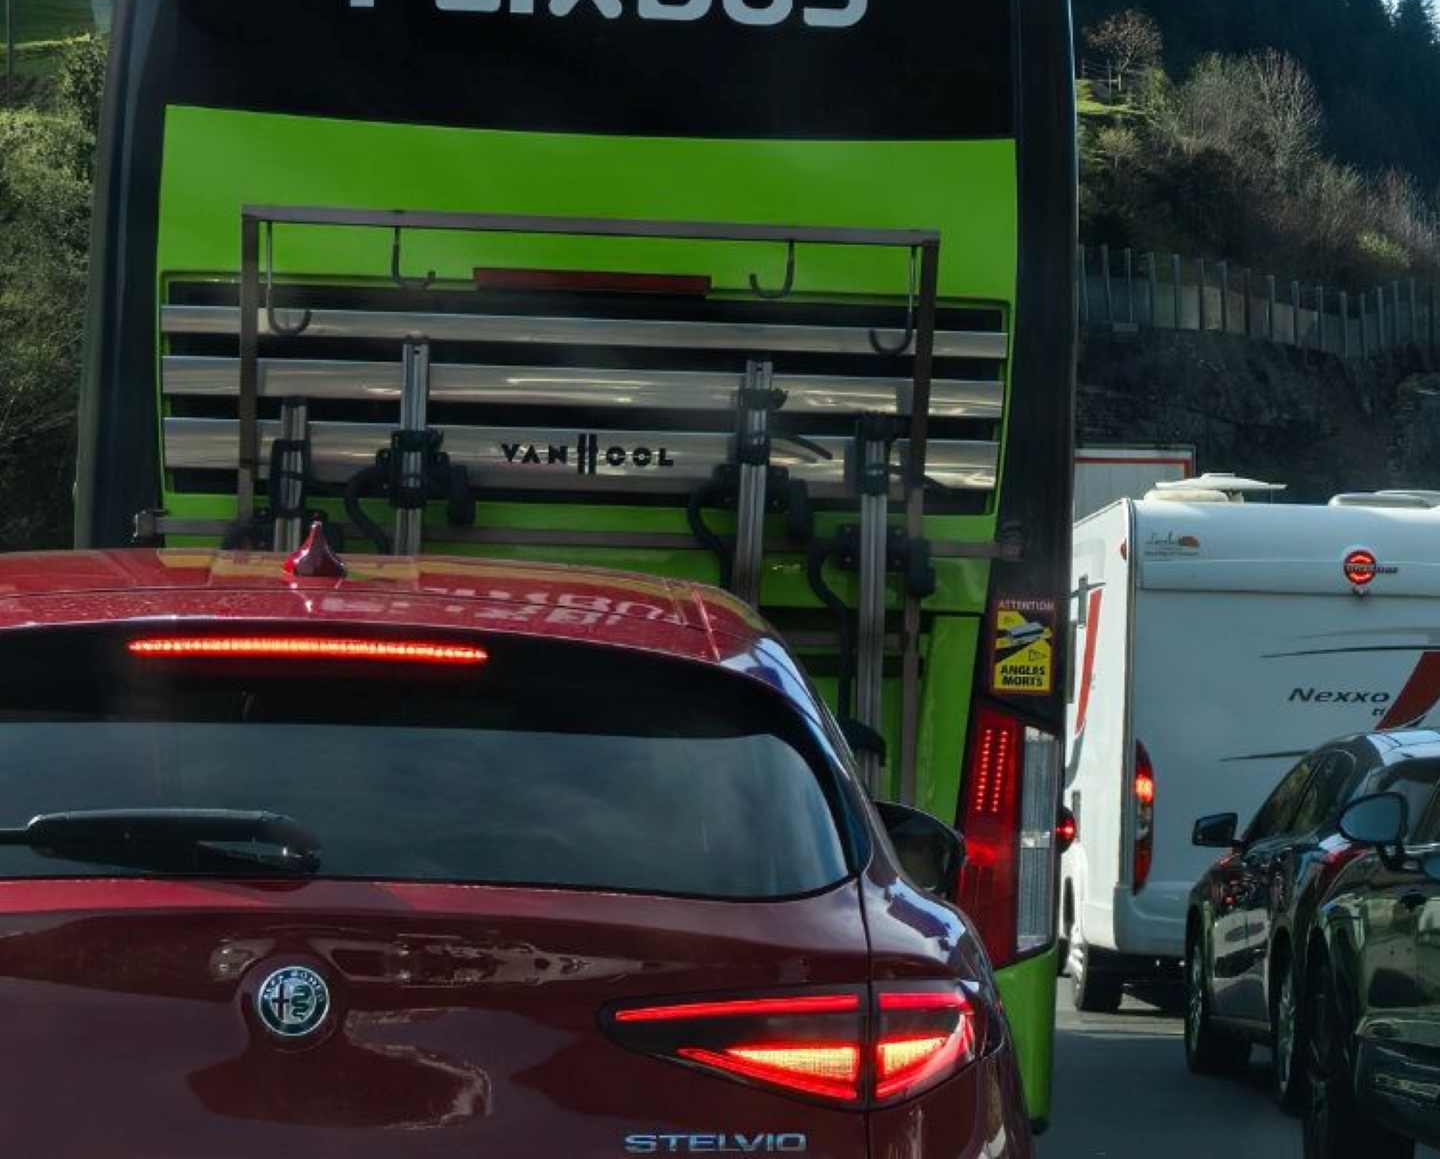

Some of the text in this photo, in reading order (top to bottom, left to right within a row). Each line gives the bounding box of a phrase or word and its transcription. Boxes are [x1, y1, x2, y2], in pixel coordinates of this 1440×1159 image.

[501, 443, 569, 464] VAN
[999, 600, 1055, 610] ATTENTION
[1001, 665, 1045, 675] ANGLES
[1002, 676, 1043, 687] MORTS
[1288, 687, 1390, 703] Nexxo
[624, 1133, 807, 1153] STELVIO
